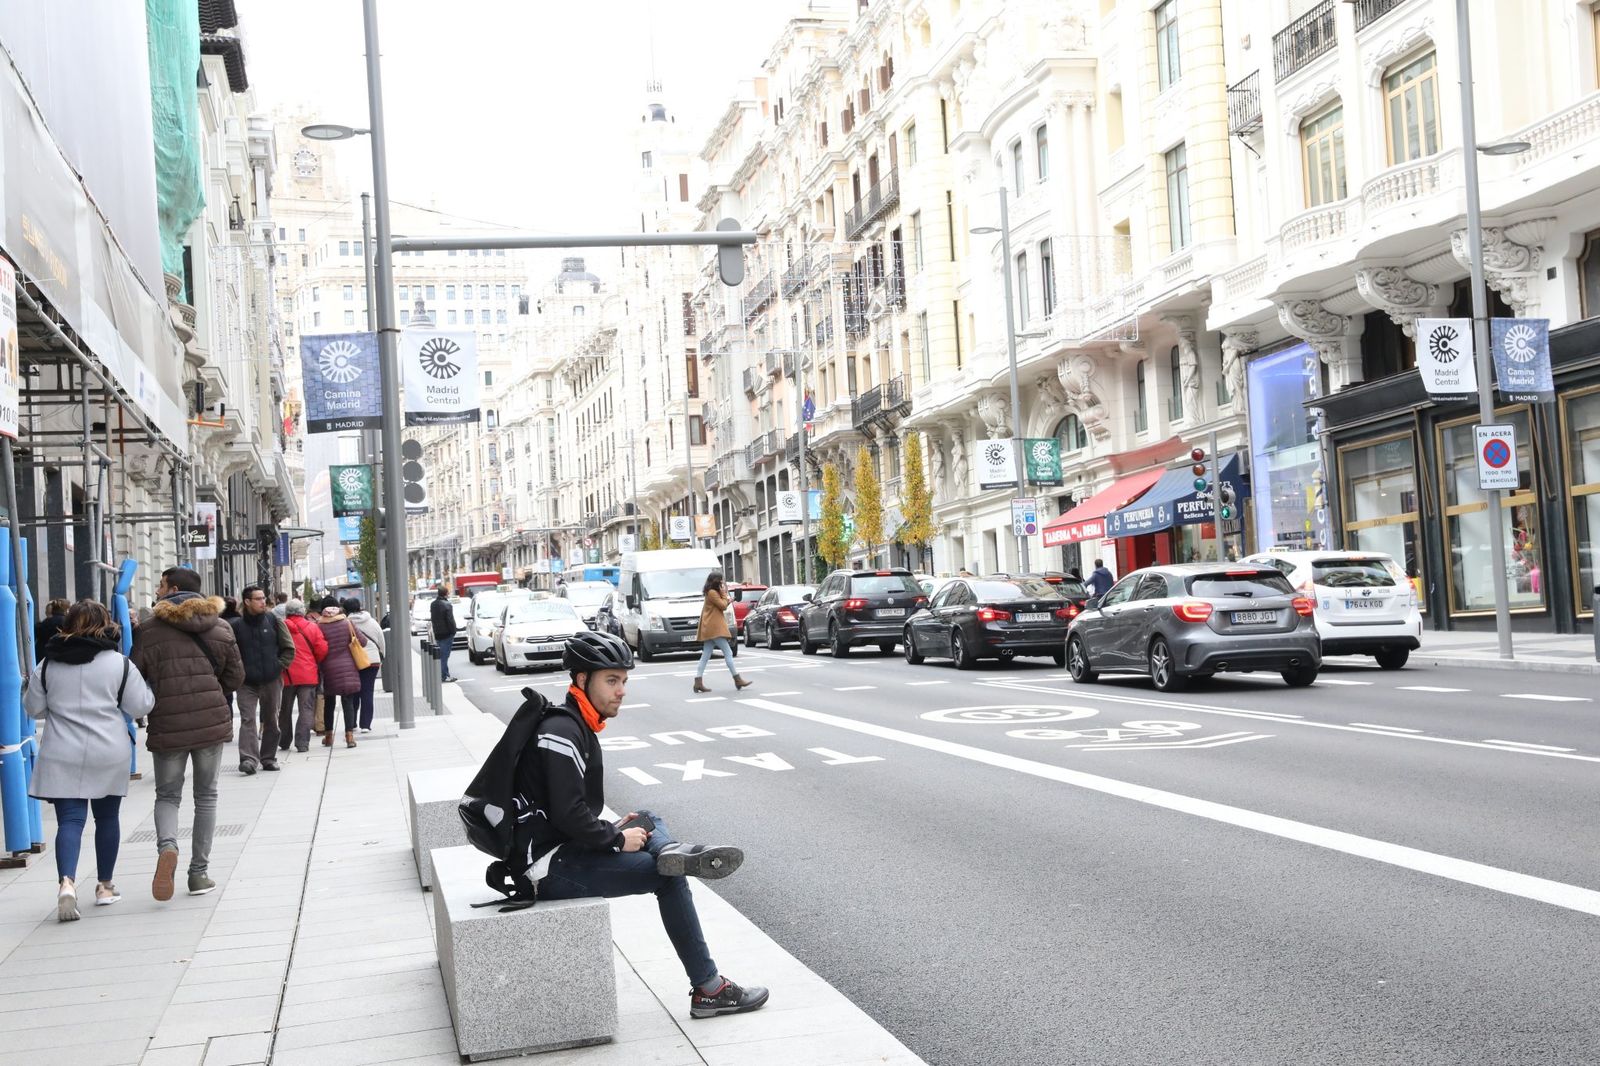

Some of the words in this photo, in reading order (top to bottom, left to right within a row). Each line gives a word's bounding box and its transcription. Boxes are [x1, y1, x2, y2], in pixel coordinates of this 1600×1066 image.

[1507, 367, 1535, 376] Camina
[1435, 378, 1460, 386] Central
[1509, 376, 1535, 385] Madrid
[426, 385, 459, 394] Madrid
[324, 390, 361, 399] Camina
[426, 395, 461, 404] Central
[327, 400, 361, 410] Madrid
[335, 421, 364, 429] MADRID
[1177, 500, 1214, 513] PERFUM
[222, 542, 257, 552] SANZ
[1350, 600, 1368, 609] 7644
[1236, 611, 1257, 621] 8880
[1259, 611, 1275, 620] JGT
[600, 724, 777, 751] BUS
[617, 747, 886, 786] TAXI
